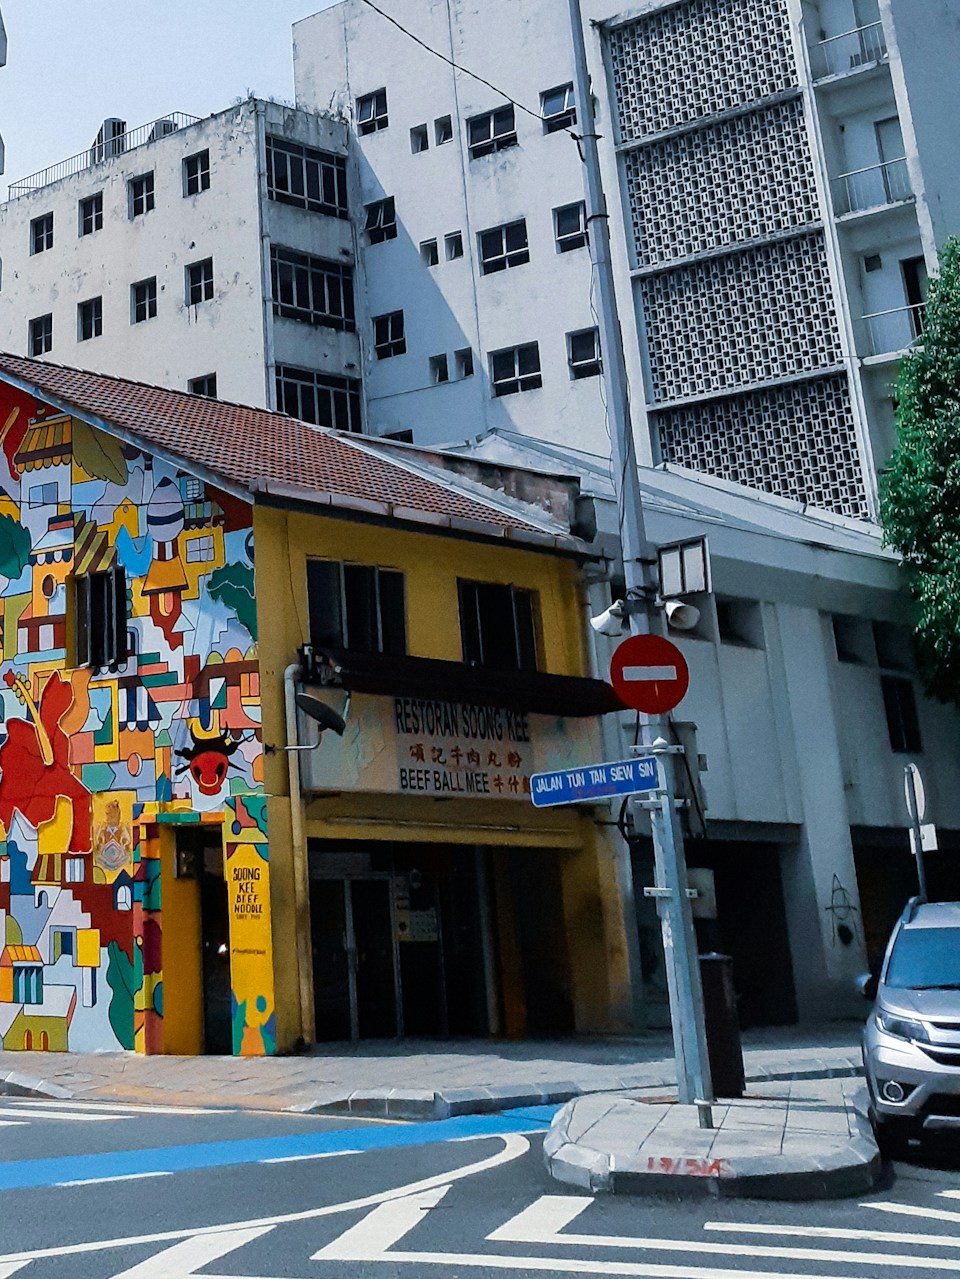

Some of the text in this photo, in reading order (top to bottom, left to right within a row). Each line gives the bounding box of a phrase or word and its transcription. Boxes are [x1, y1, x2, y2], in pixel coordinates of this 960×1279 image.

[394, 698, 530, 743] RESTORAN SOONG KEE
[399, 768, 490, 793] BEEF BALL MEE
[535, 775, 563, 793] JALAN
[566, 772, 586, 789] TUN
[589, 768, 607, 784] TAN
[610, 764, 634, 781] SIEW
[638, 761, 654, 778] SIN
[233, 867, 261, 881] SOONG
[239, 882, 255, 894] KEE
[236, 894, 259, 903] BEEF
[234, 904, 263, 913] NOODLE
